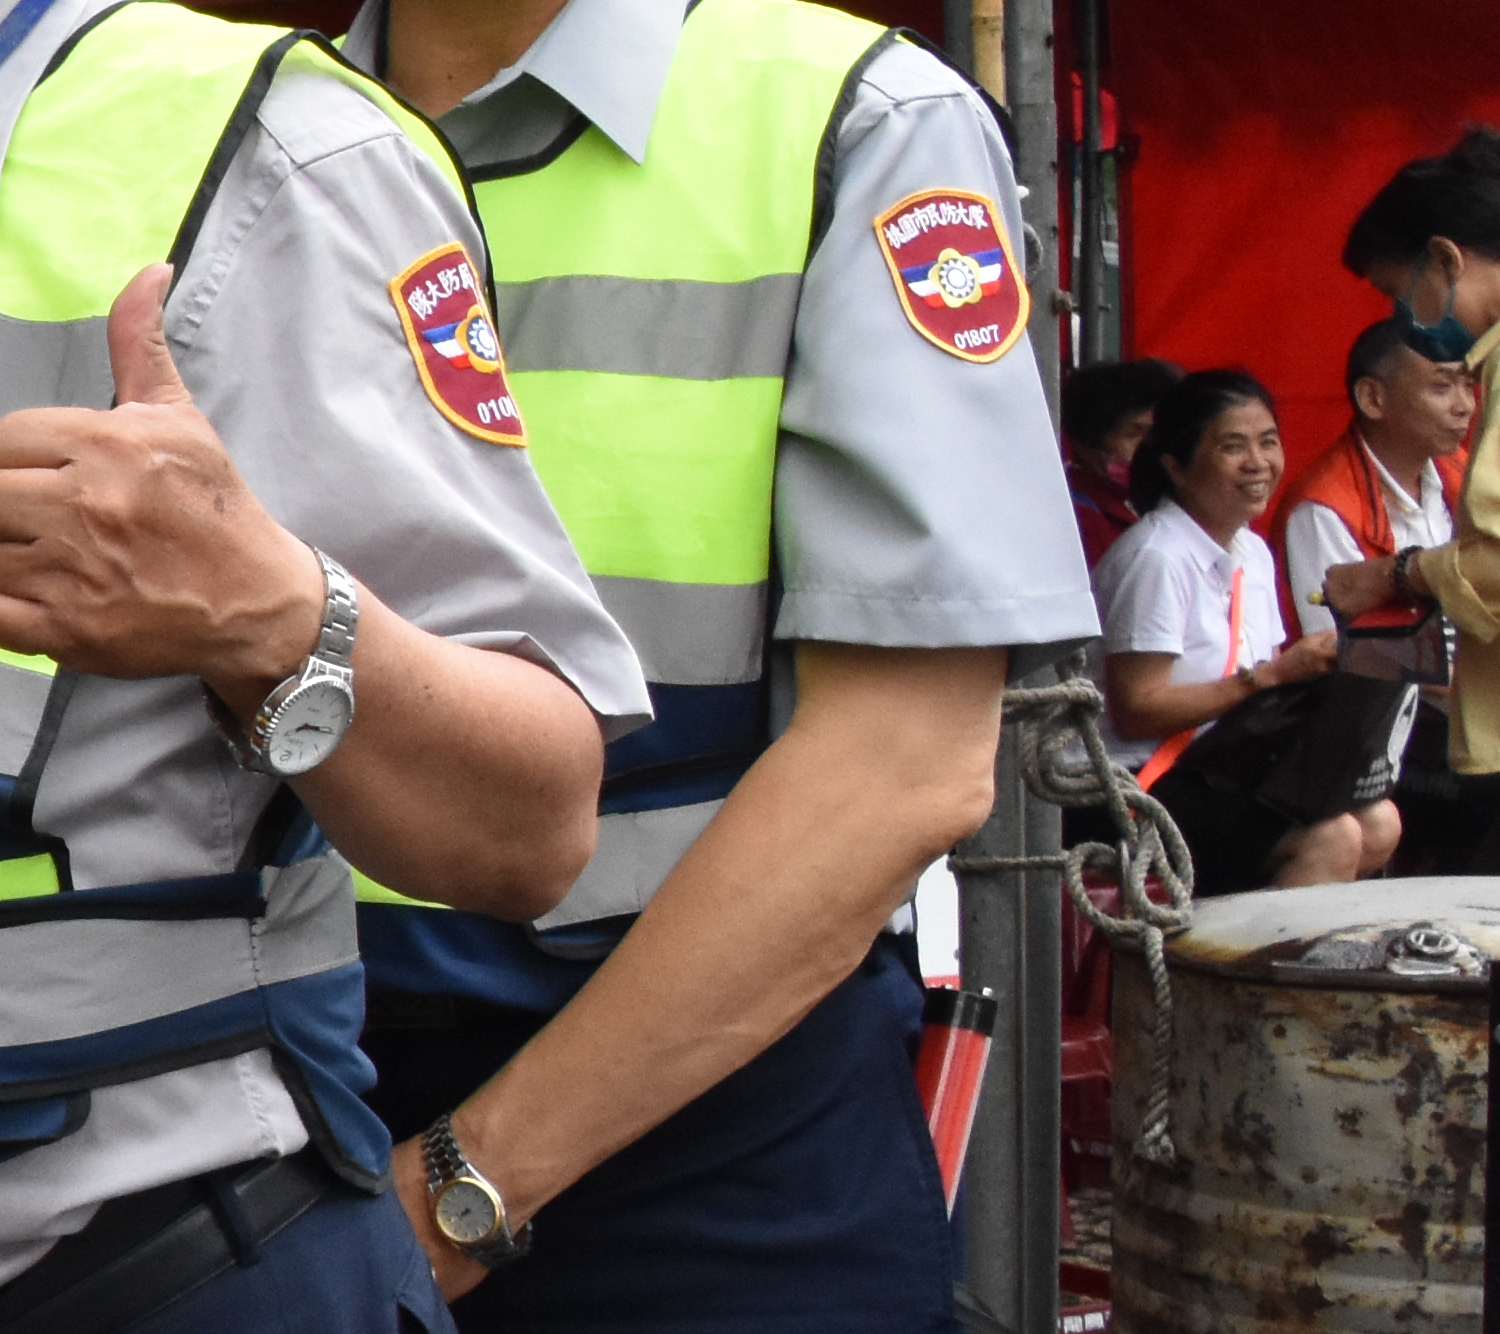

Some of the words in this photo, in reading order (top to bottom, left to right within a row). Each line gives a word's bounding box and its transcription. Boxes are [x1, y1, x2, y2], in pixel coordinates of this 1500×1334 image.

[883, 201, 989, 249] 桃園市民防大隊
[953, 324, 1000, 350] 01807
